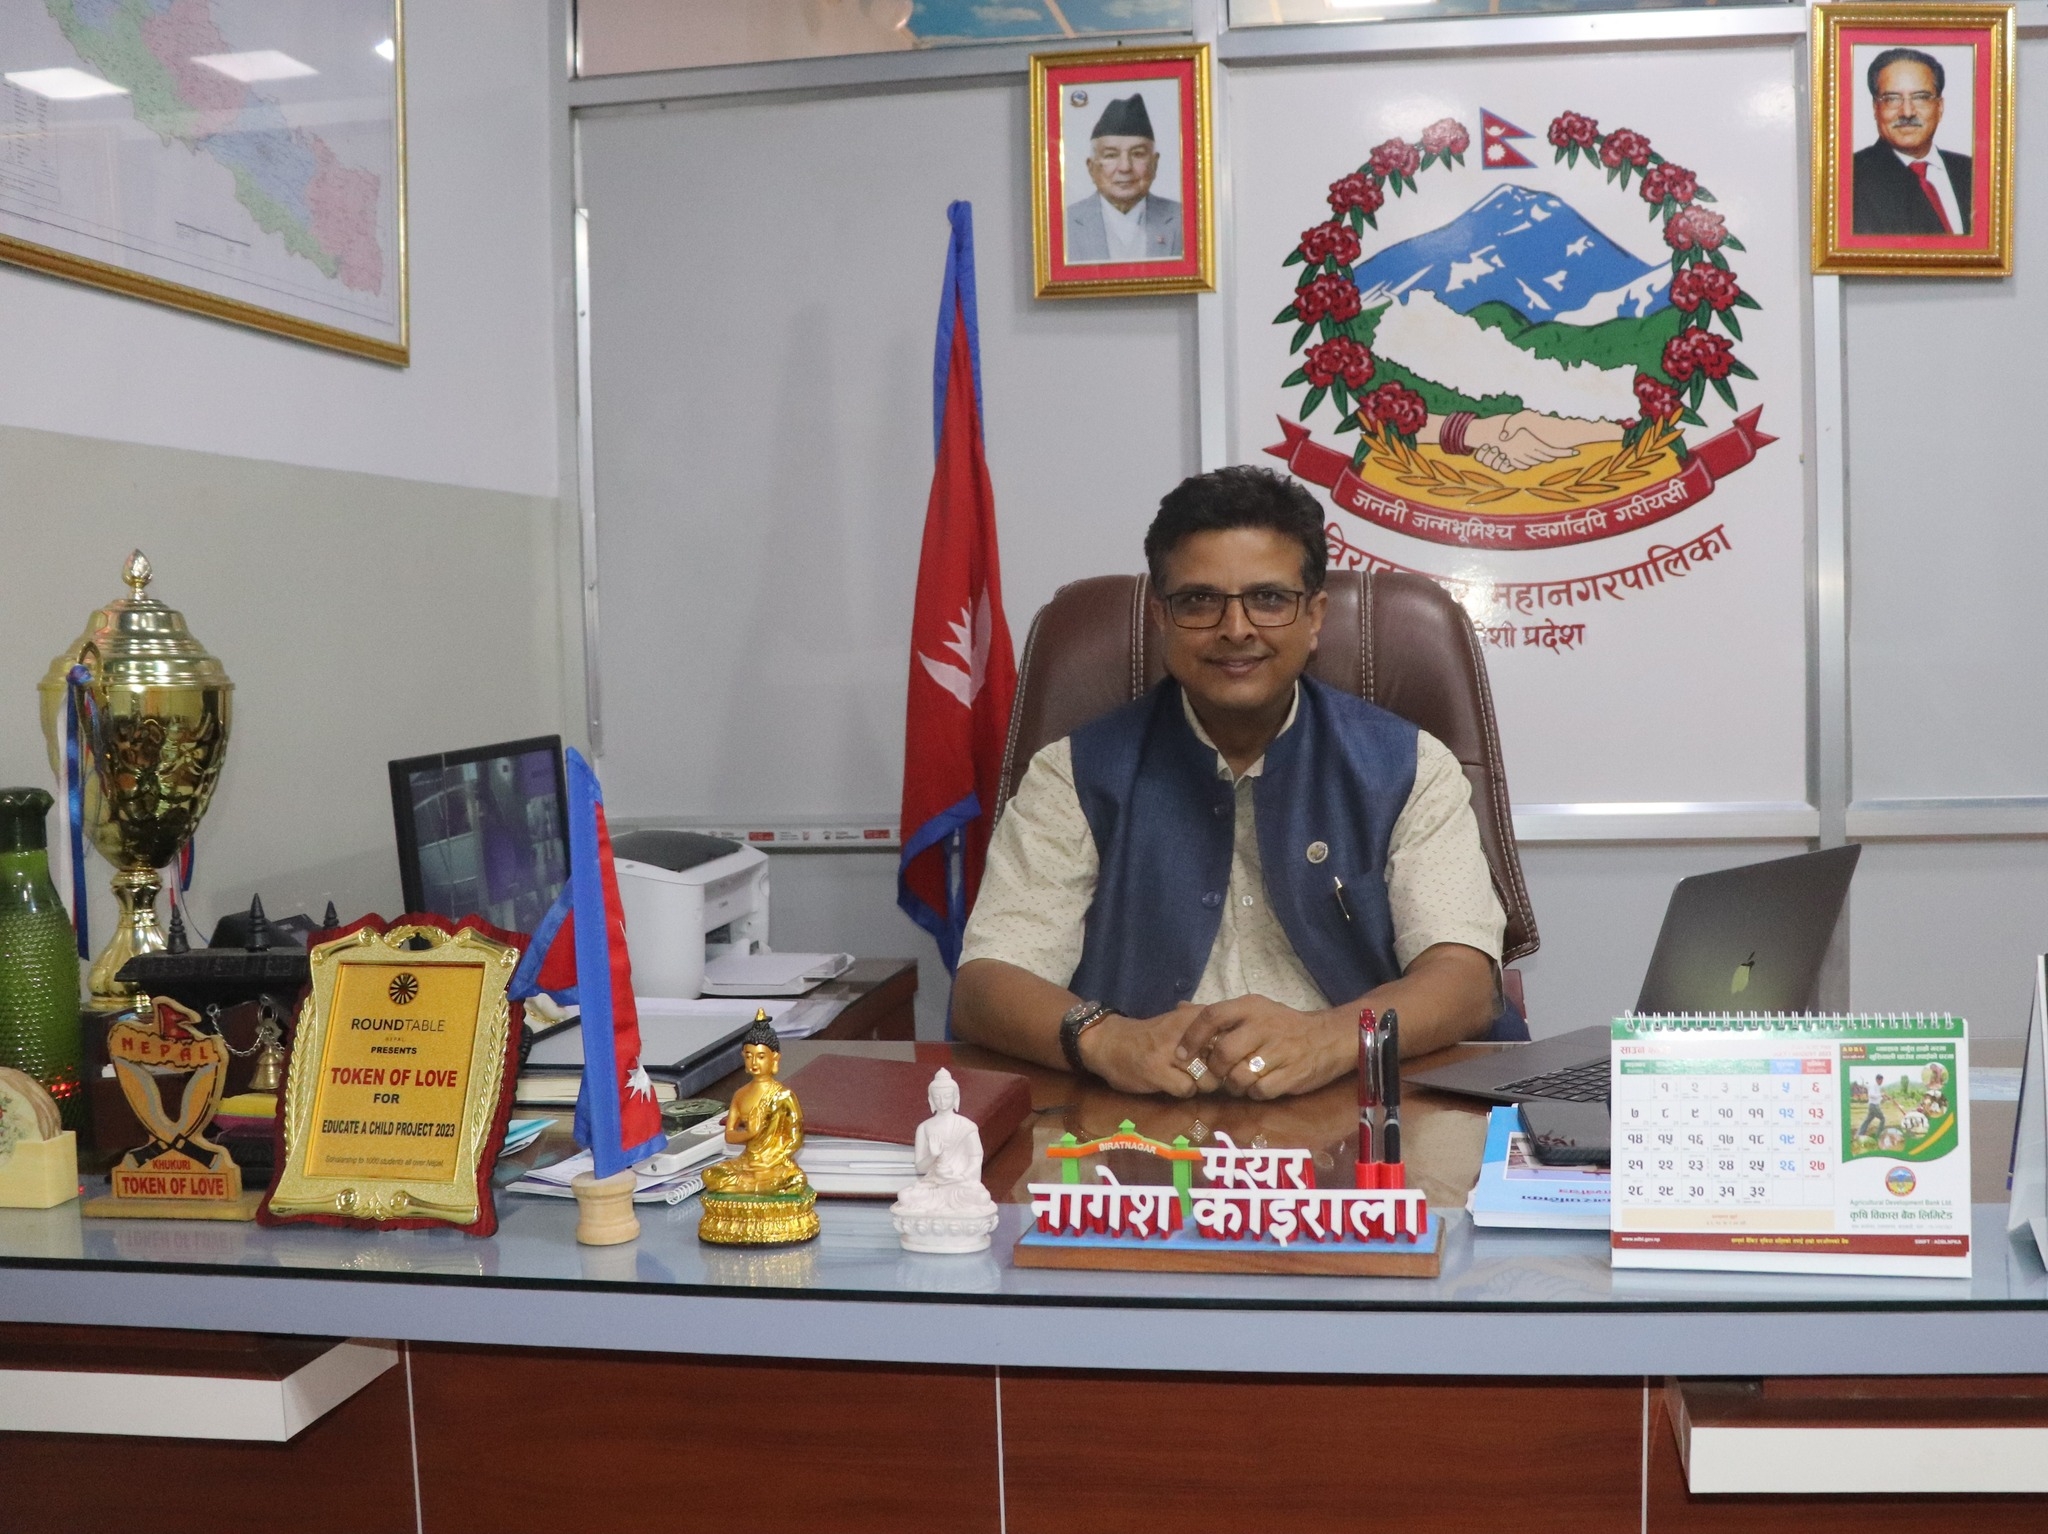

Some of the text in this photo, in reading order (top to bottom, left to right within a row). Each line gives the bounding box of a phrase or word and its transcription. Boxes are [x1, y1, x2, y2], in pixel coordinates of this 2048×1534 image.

[1352, 480, 1688, 543] जननी जन्मभूमिश्च स्वर्गादपि गरीयसी
[1491, 523, 1733, 616] महानगरपालिका
[1473, 617, 1586, 655] ोशी प्रदेश
[351, 1018, 445, 1032] ROUNDTABLE
[121, 1037, 209, 1062] NEPAL
[370, 1046, 417, 1055] PRESENTS
[331, 1067, 458, 1088] TOKEN OF LOVE
[373, 1093, 400, 1104] FOR
[1718, 1108, 1734, 1119] १०
[1748, 1107, 1764, 1119] ११
[1778, 1107, 1795, 1119] १२
[1808, 1107, 1825, 1120] १३
[321, 1119, 456, 1138] EDUCATE A CHILD PROJECT 2023
[1627, 1133, 1825, 1146] १४ १५ १६ १७ १८ १९ २०
[1098, 1140, 1157, 1155] BIRATNAGAR
[152, 1159, 191, 1170] KHUKURI
[379, 1157, 403, 1165] students
[1200, 1130, 1311, 1189] मेयर
[1628, 1159, 1826, 1172] २१ २२ २३ २४ २५ २६ २७
[121, 1176, 224, 1196] TOKEN OF LOVE
[1628, 1185, 1765, 1198] २८ २९ ३० ३१ ३२
[1027, 1165, 1428, 1247] नागेश कोइराला
[1850, 1199, 1883, 1207] Agricultural
[1885, 1199, 1923, 1207] Development
[1850, 1209, 1868, 1221] कृषि
[1870, 1209, 1899, 1220] विकास
[1918, 1209, 1953, 1220] लिमिटेड
